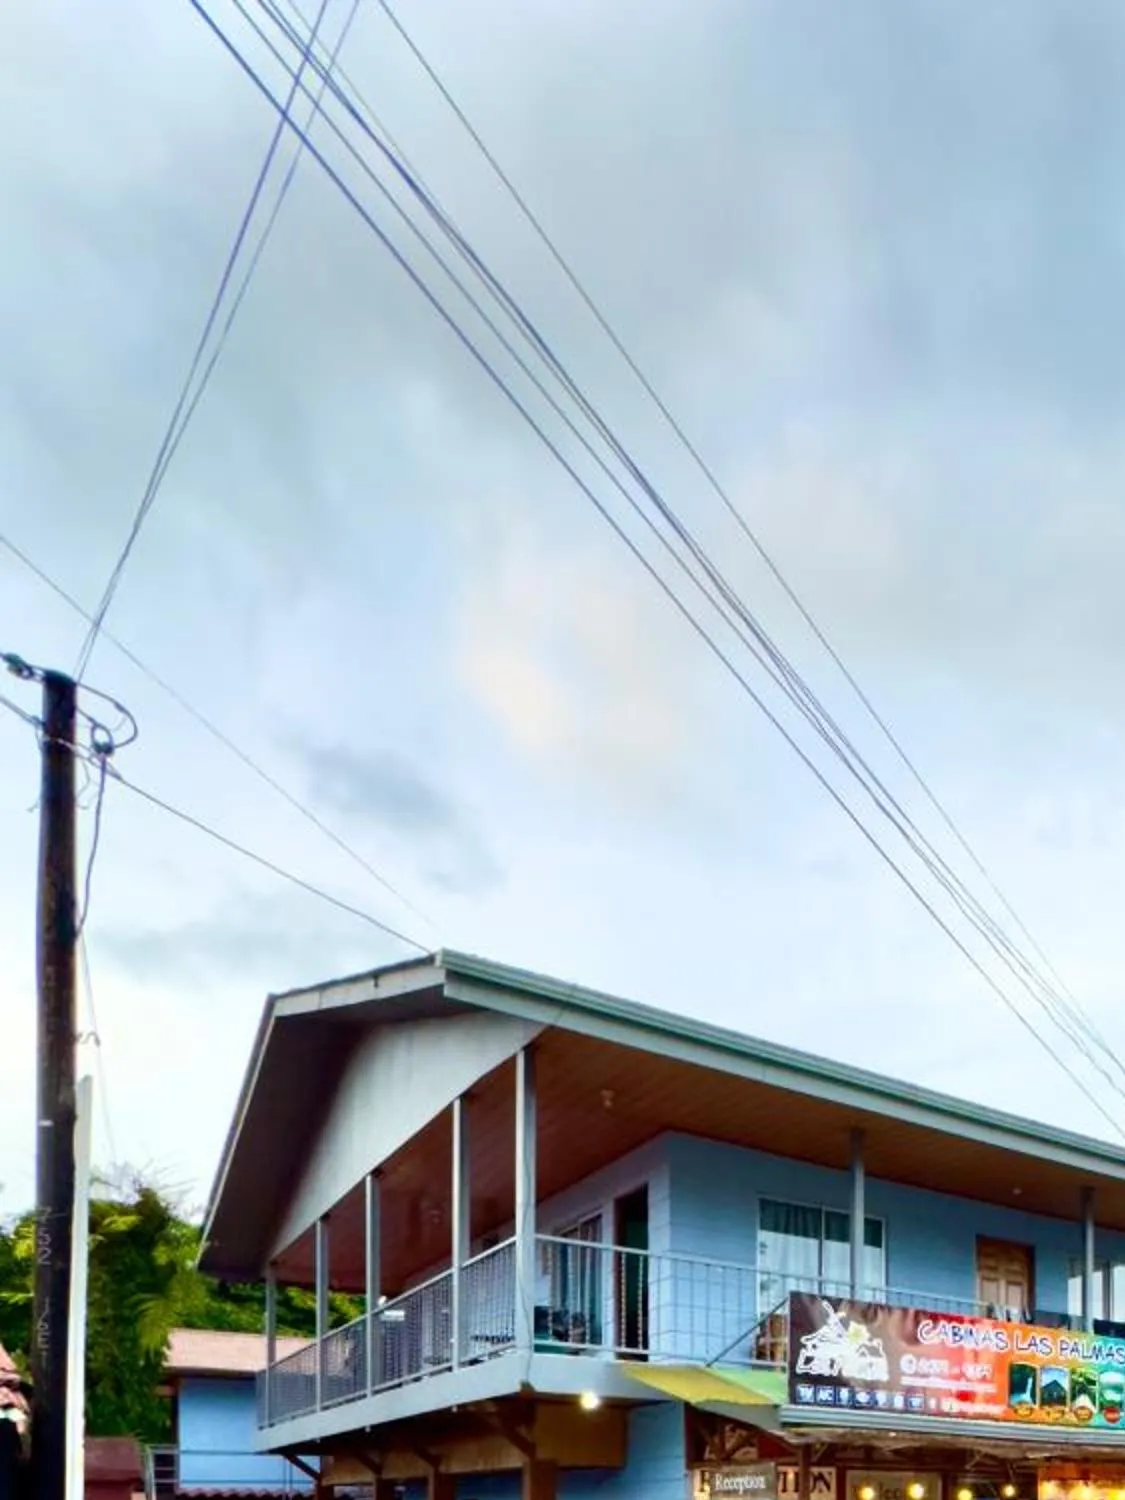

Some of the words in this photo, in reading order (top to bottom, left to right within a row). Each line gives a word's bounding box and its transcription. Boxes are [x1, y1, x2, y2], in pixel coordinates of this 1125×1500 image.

[917, 1320, 1008, 1351] CABINAS
[1014, 1332, 1052, 1357] LAS
[715, 1473, 766, 1494] Reception
